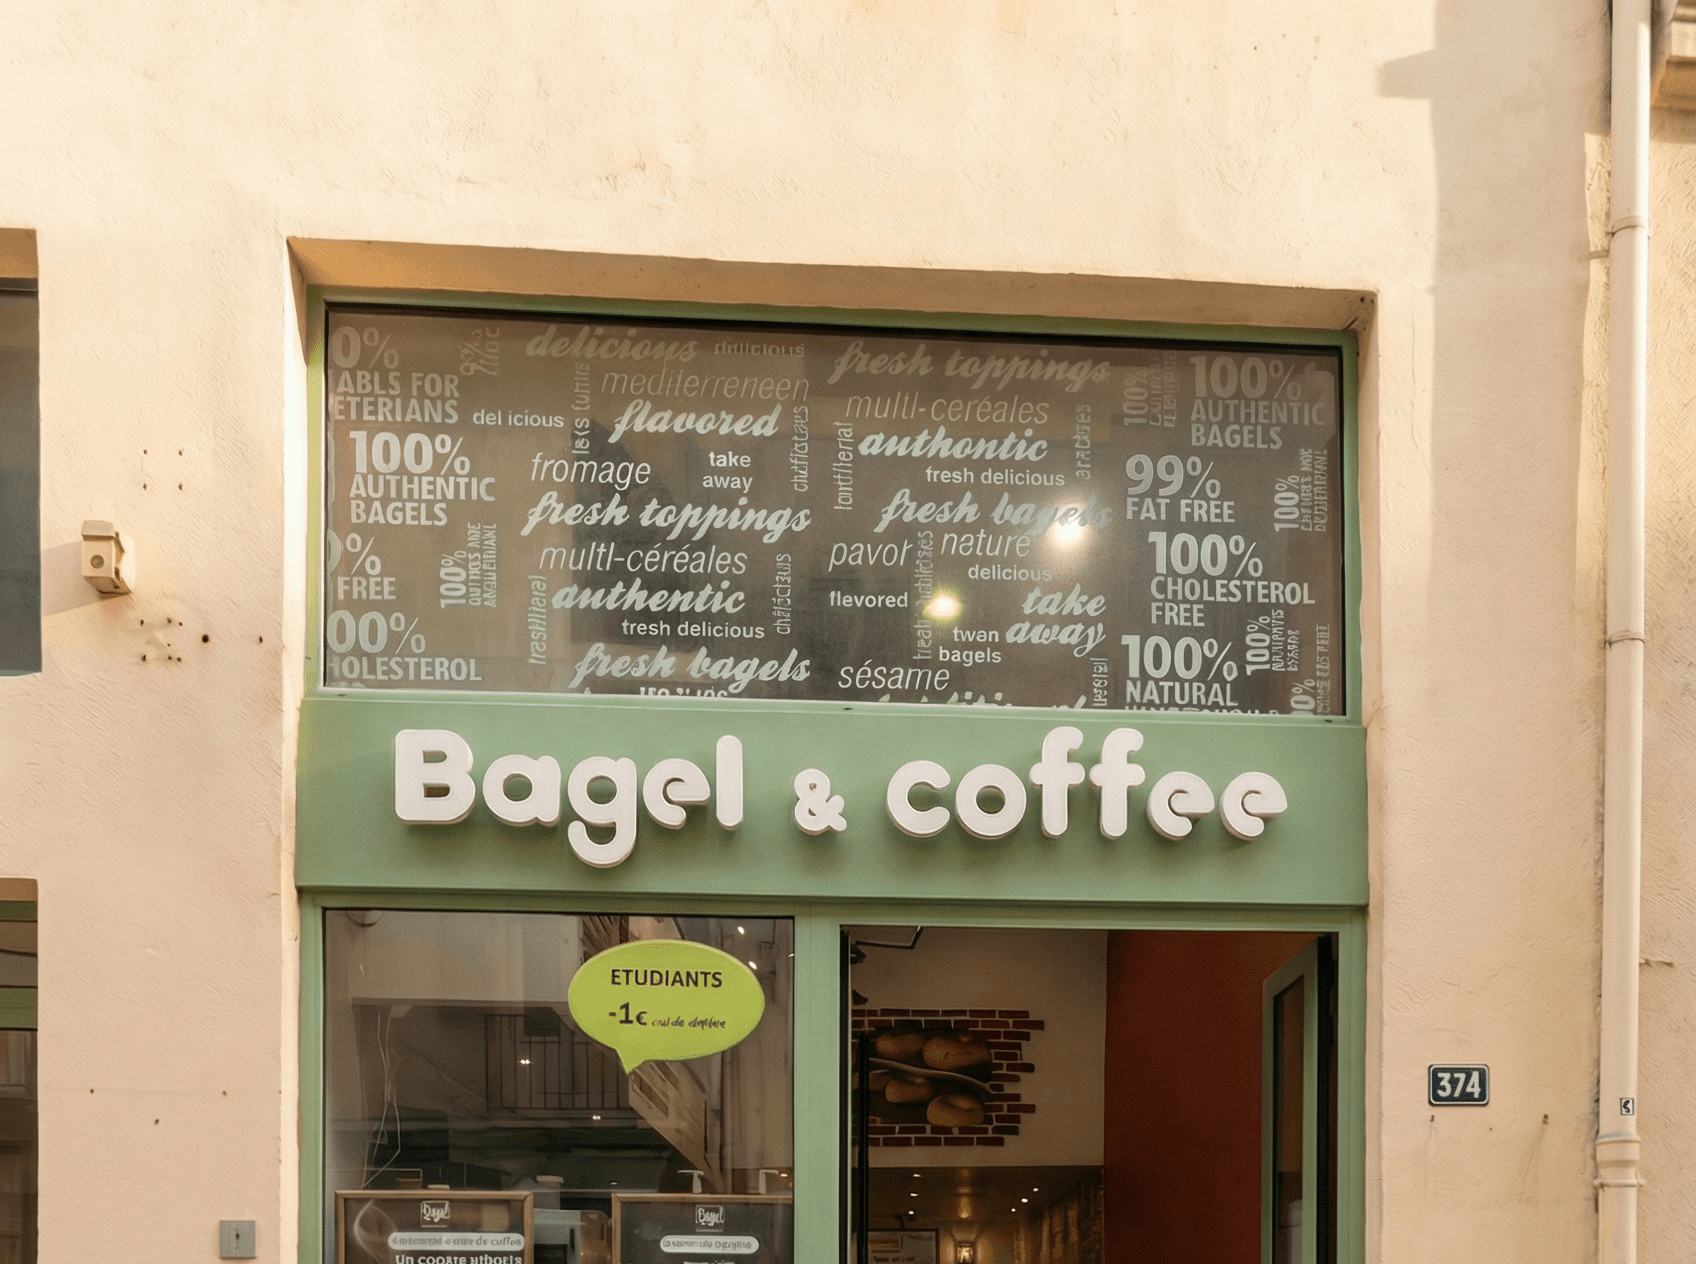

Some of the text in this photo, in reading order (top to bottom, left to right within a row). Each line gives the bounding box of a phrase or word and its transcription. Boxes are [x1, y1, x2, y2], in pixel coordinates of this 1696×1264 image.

[525, 324, 698, 362] delicious
[827, 339, 934, 385] fresh
[944, 348, 1111, 393] toppings
[1189, 355, 1301, 401] 100%
[411, 372, 460, 398] FOR
[608, 399, 782, 443] flavored
[1190, 399, 1325, 426] AUTHENTIC
[349, 431, 471, 475] 100%
[1191, 423, 1283, 450] BAGELS
[531, 452, 651, 491] fromage
[709, 451, 751, 468] take
[1125, 454, 1221, 498] 99%
[349, 474, 496, 501] AUTHENTIC
[703, 474, 753, 493] away
[981, 468, 1065, 487] delicious
[351, 500, 448, 526] BAGELS
[520, 490, 811, 544] fresh toppings
[873, 488, 981, 533] fresh
[1126, 497, 1235, 523] FAT FREE
[1274, 475, 1300, 532] 100%
[1148, 531, 1263, 578] 100%
[337, 577, 397, 600] FREE
[440, 550, 467, 609] 100%
[968, 564, 1053, 581] delicious
[551, 577, 746, 614] authentic
[1022, 583, 1107, 617] take
[1151, 576, 1316, 605] CHOLESTEROL
[677, 620, 766, 639] delicious
[1151, 602, 1205, 627] FREE
[327, 609, 426, 655] 00%
[1005, 620, 1107, 658] away
[1245, 615, 1270, 677] 100%
[568, 642, 811, 693] fresh bagels
[938, 646, 1003, 667] bagels
[1121, 634, 1239, 682] 100%
[837, 659, 950, 691] sésame
[1126, 680, 1239, 707] NATURAL
[394, 726, 1288, 869] Bagel & coffee
[610, 968, 723, 988] ETUDIANTS
[1436, 1070, 1481, 1099] 374
